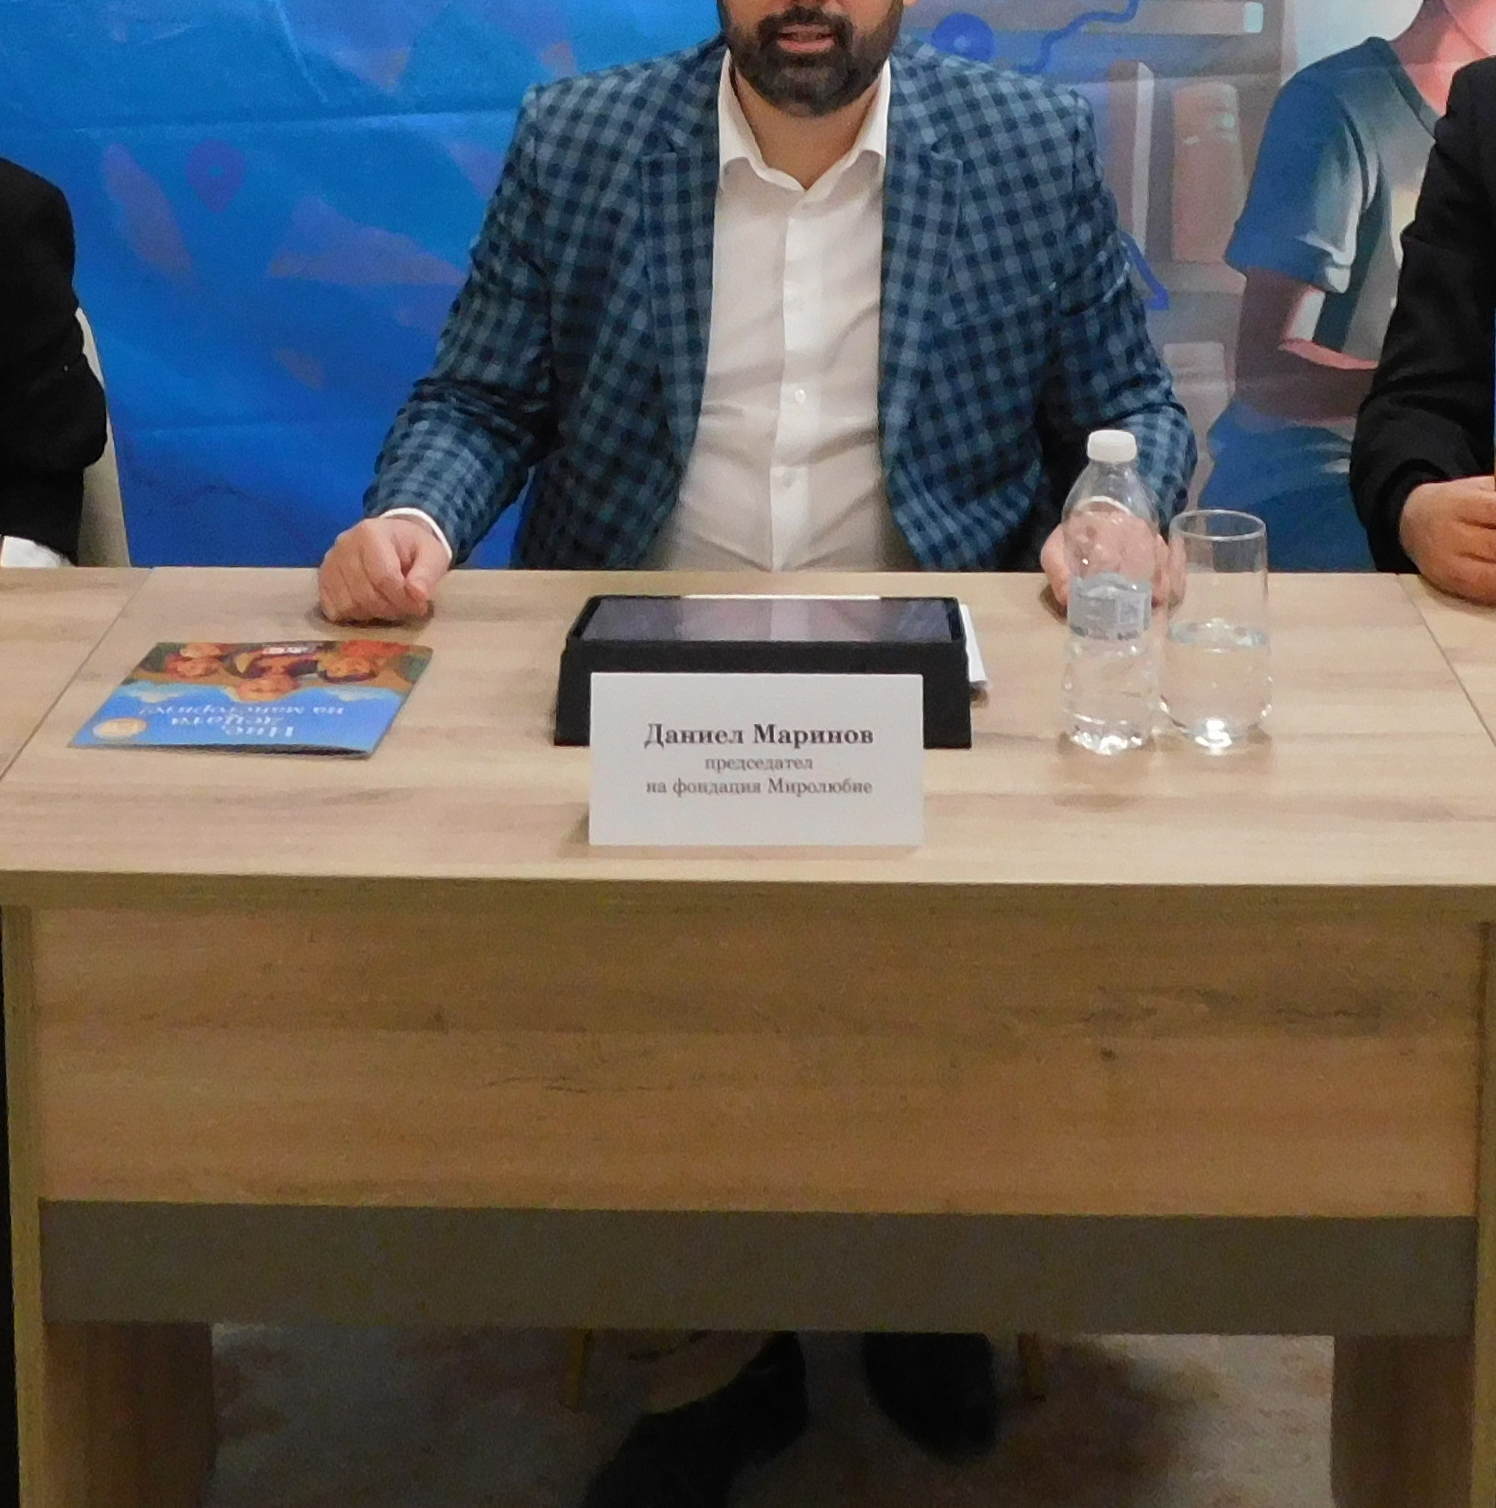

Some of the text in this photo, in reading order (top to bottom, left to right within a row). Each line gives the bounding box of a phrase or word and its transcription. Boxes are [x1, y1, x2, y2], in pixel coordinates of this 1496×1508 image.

[644, 723, 874, 749] Даниел Маринов
[704, 757, 813, 774] председател
[646, 776, 874, 797] на фондация Миролюбие
